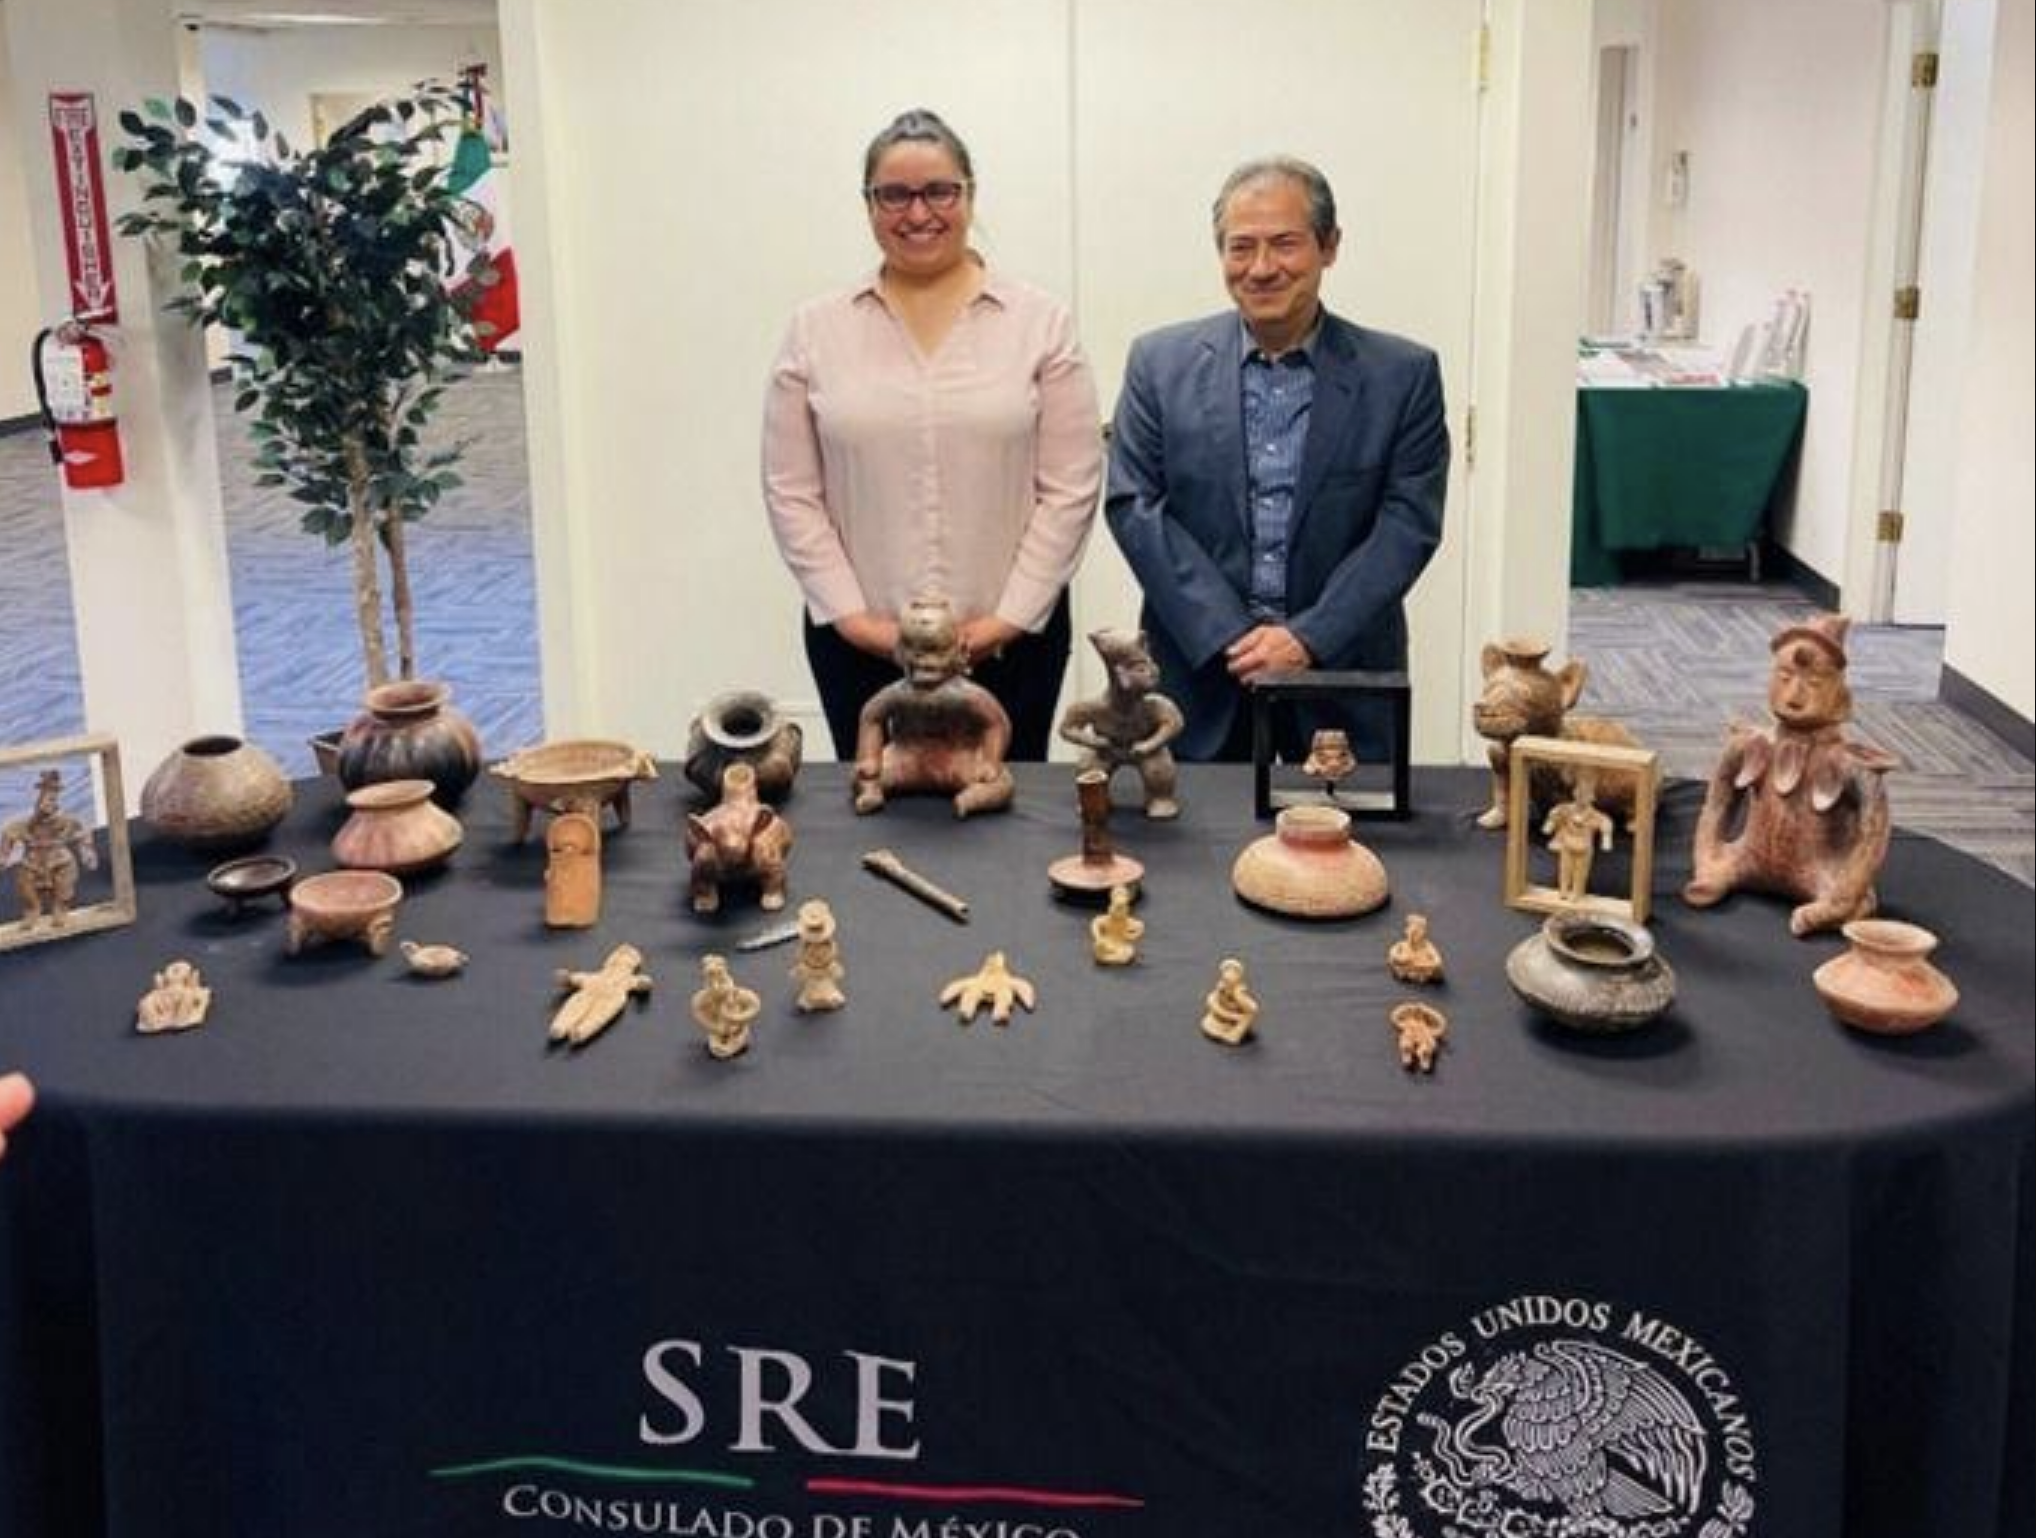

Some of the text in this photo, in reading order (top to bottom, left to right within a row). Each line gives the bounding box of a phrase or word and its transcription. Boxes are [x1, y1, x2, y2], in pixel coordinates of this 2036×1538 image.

[639, 1339, 921, 1460] SRE
[1366, 1296, 1757, 1482] ESTADOS UNIDOS MEXICANOS
[503, 1484, 794, 1538] CONSULADO
[812, 1514, 873, 1538] DE
